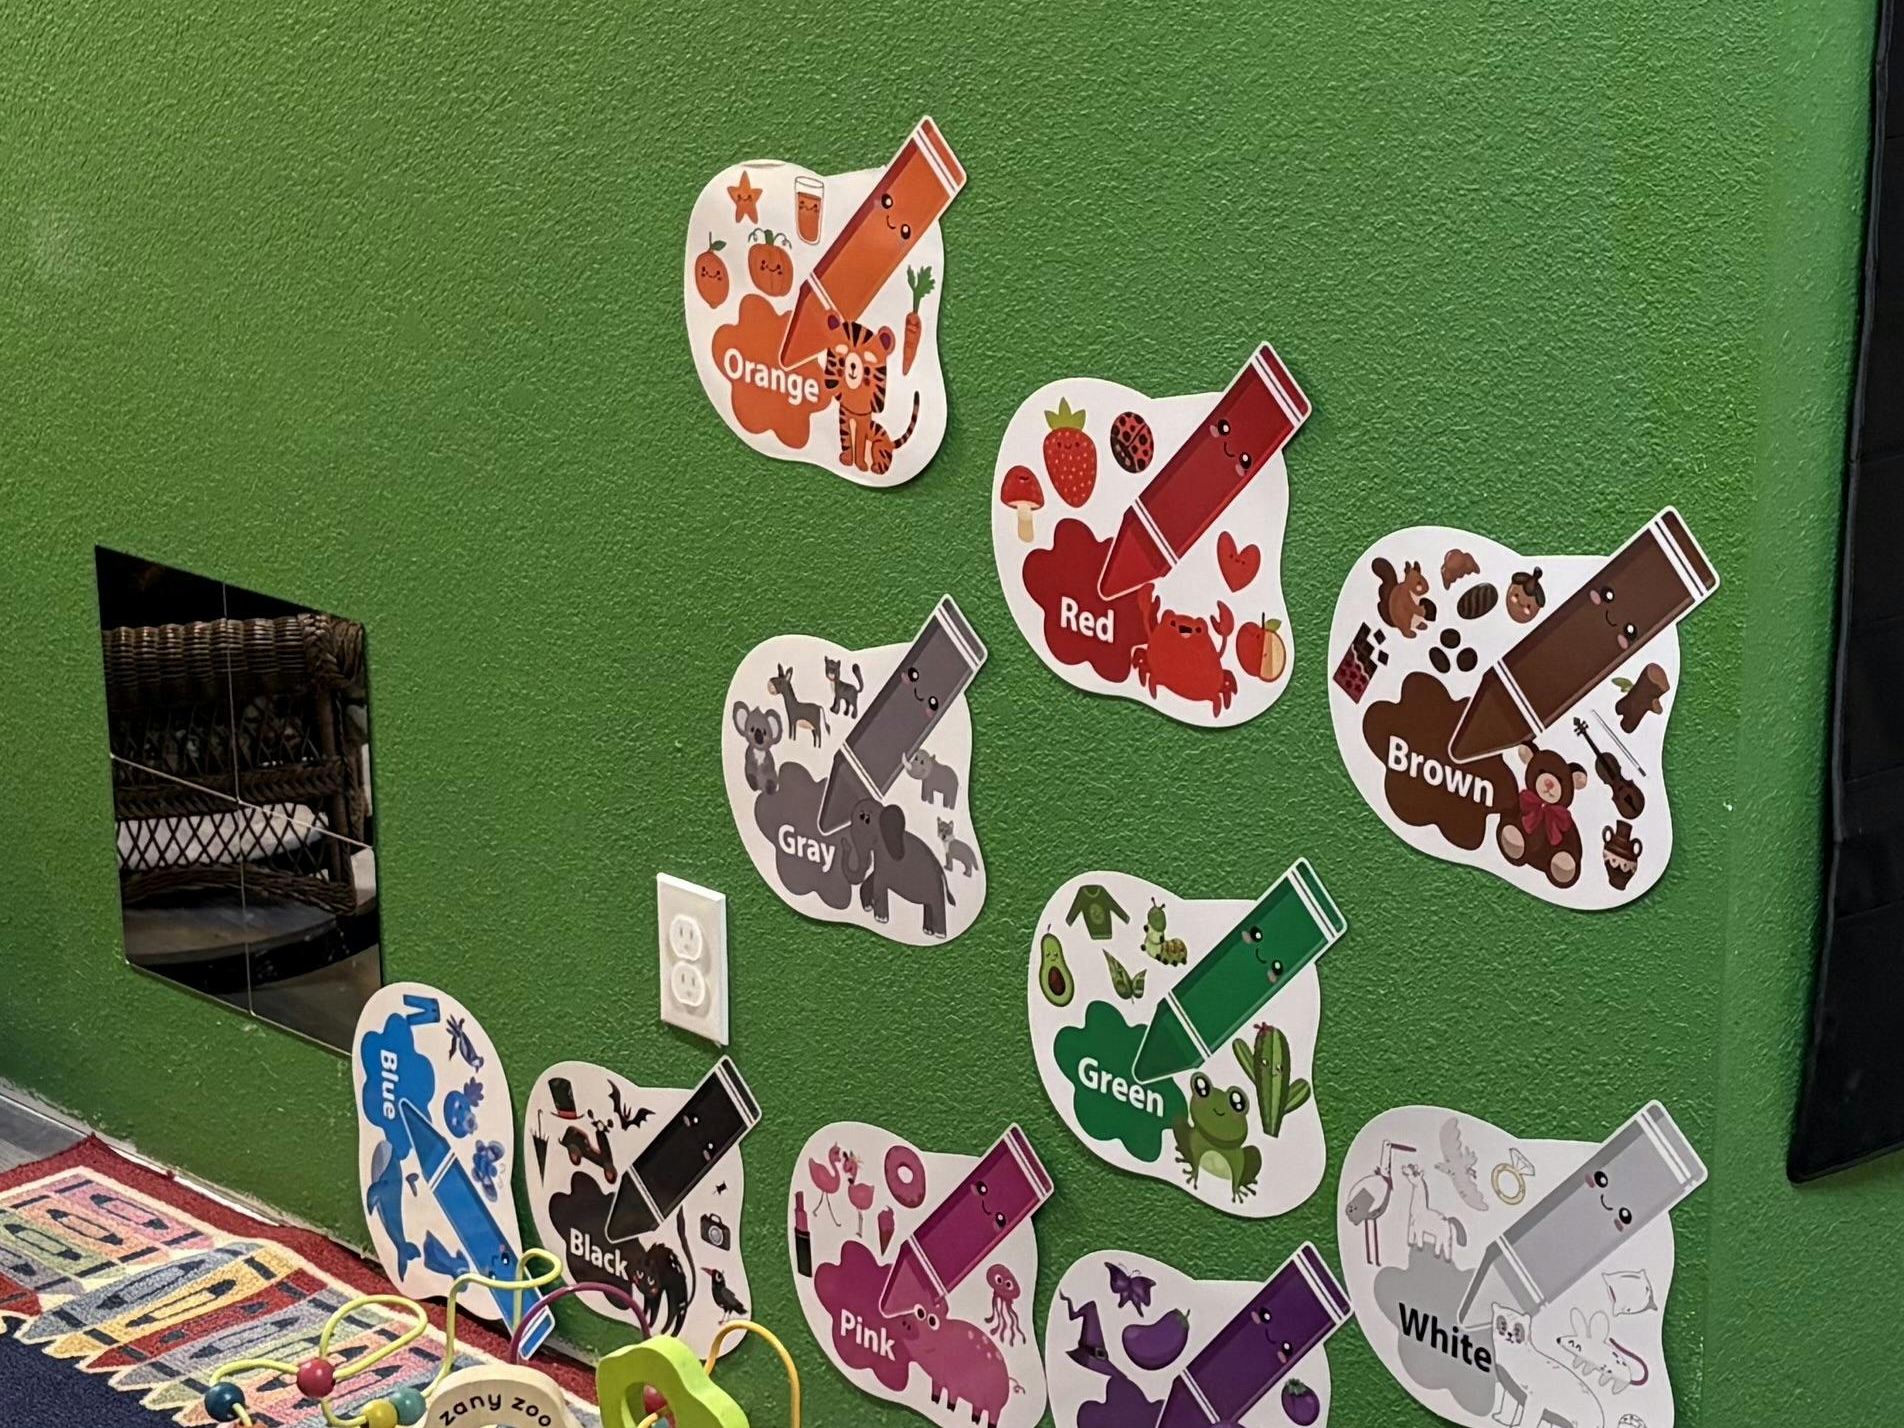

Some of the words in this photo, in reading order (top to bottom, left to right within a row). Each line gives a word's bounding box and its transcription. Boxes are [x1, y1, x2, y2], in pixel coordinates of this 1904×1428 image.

[723, 347, 820, 405] Orange
[1059, 596, 1116, 645] Red
[1385, 735, 1496, 808] Brown
[778, 823, 836, 871] Gray
[379, 1049, 398, 1121] Blue
[1076, 1058, 1165, 1119] Green
[569, 1227, 629, 1282] Black
[840, 1315, 896, 1363] Pink
[1397, 1301, 1496, 1374] White
[439, 1394, 501, 1426] zany
[511, 1396, 551, 1427] zoo
